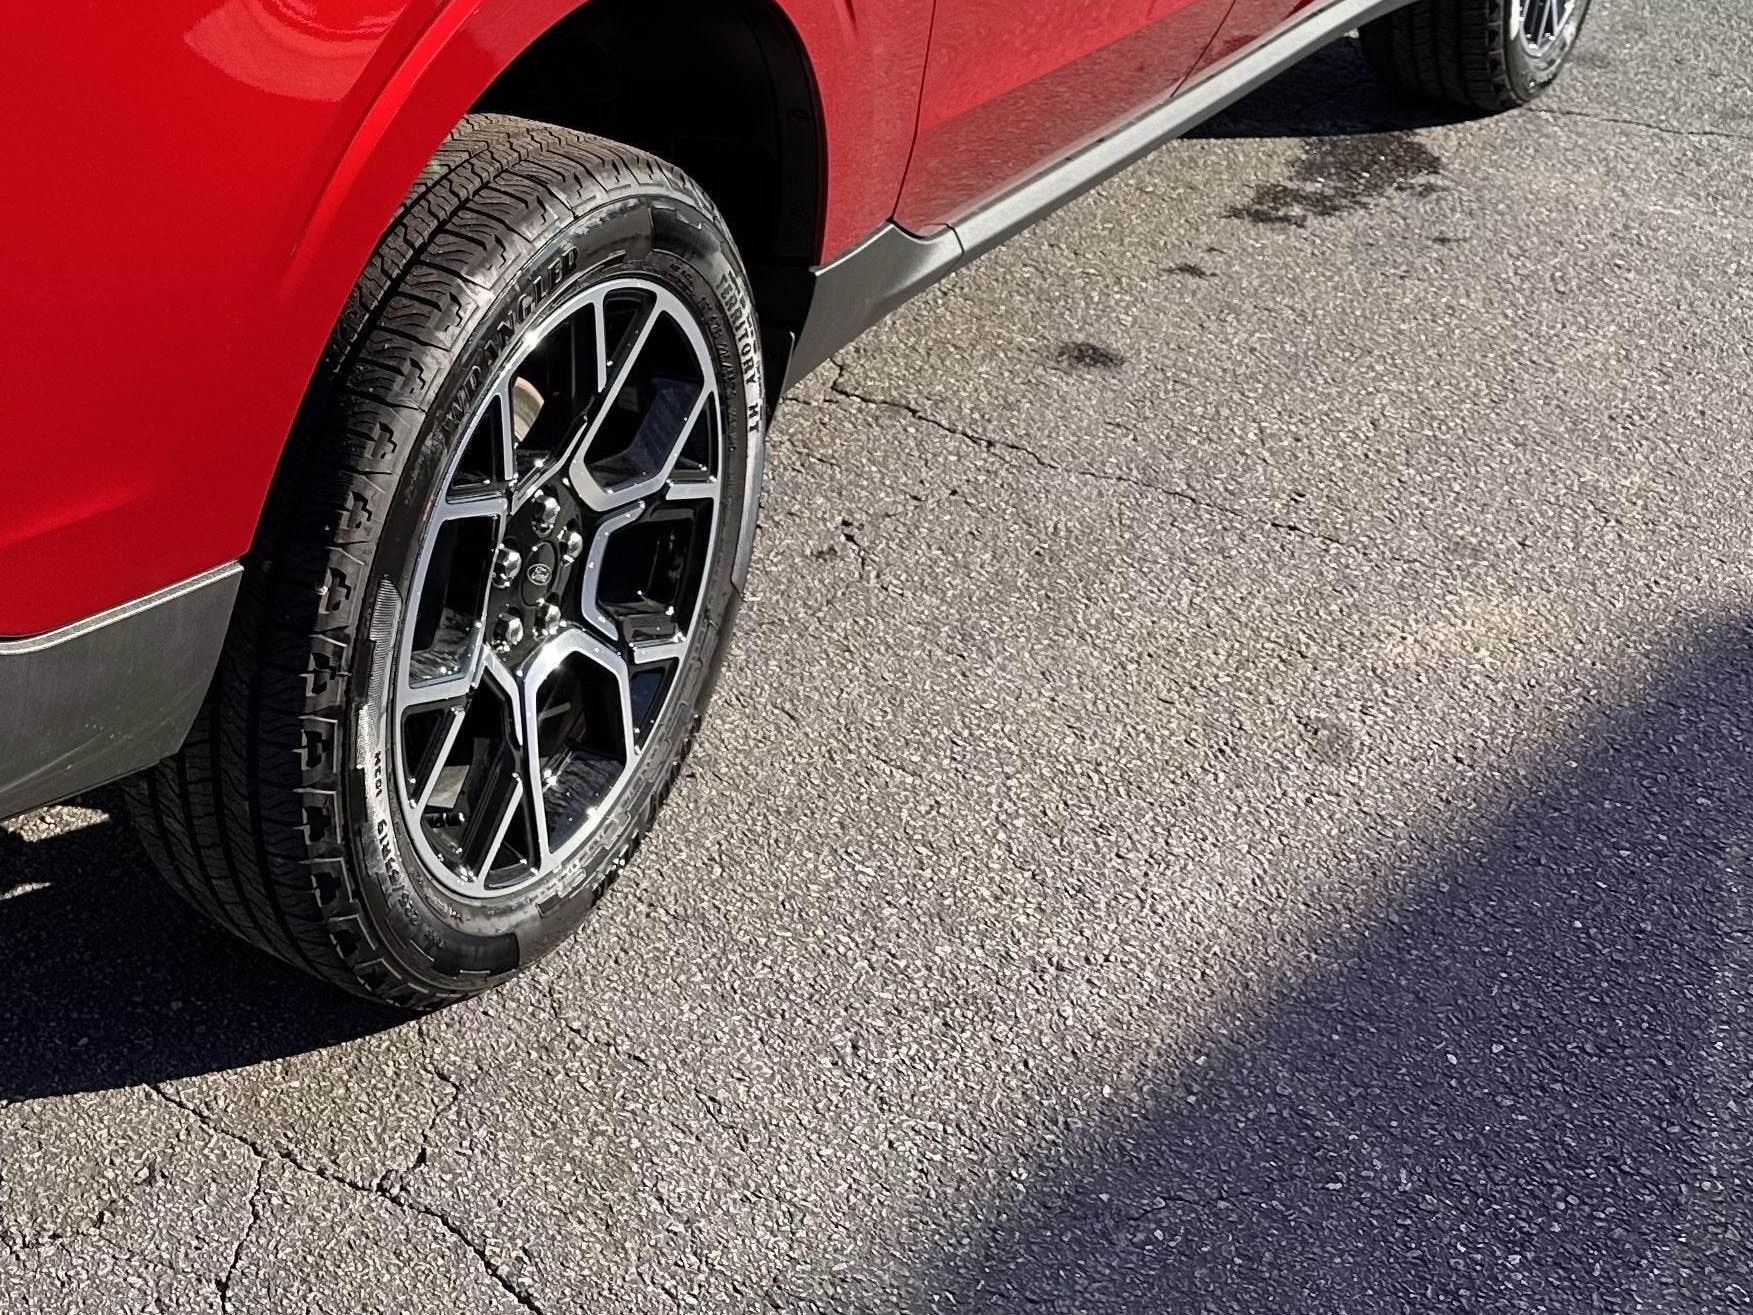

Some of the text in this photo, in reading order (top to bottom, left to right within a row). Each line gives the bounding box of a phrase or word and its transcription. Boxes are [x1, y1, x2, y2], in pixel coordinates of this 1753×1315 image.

[442, 245, 578, 432] WRANGLER
[715, 271, 757, 385] TERRITORY
[748, 402, 761, 433] HT
